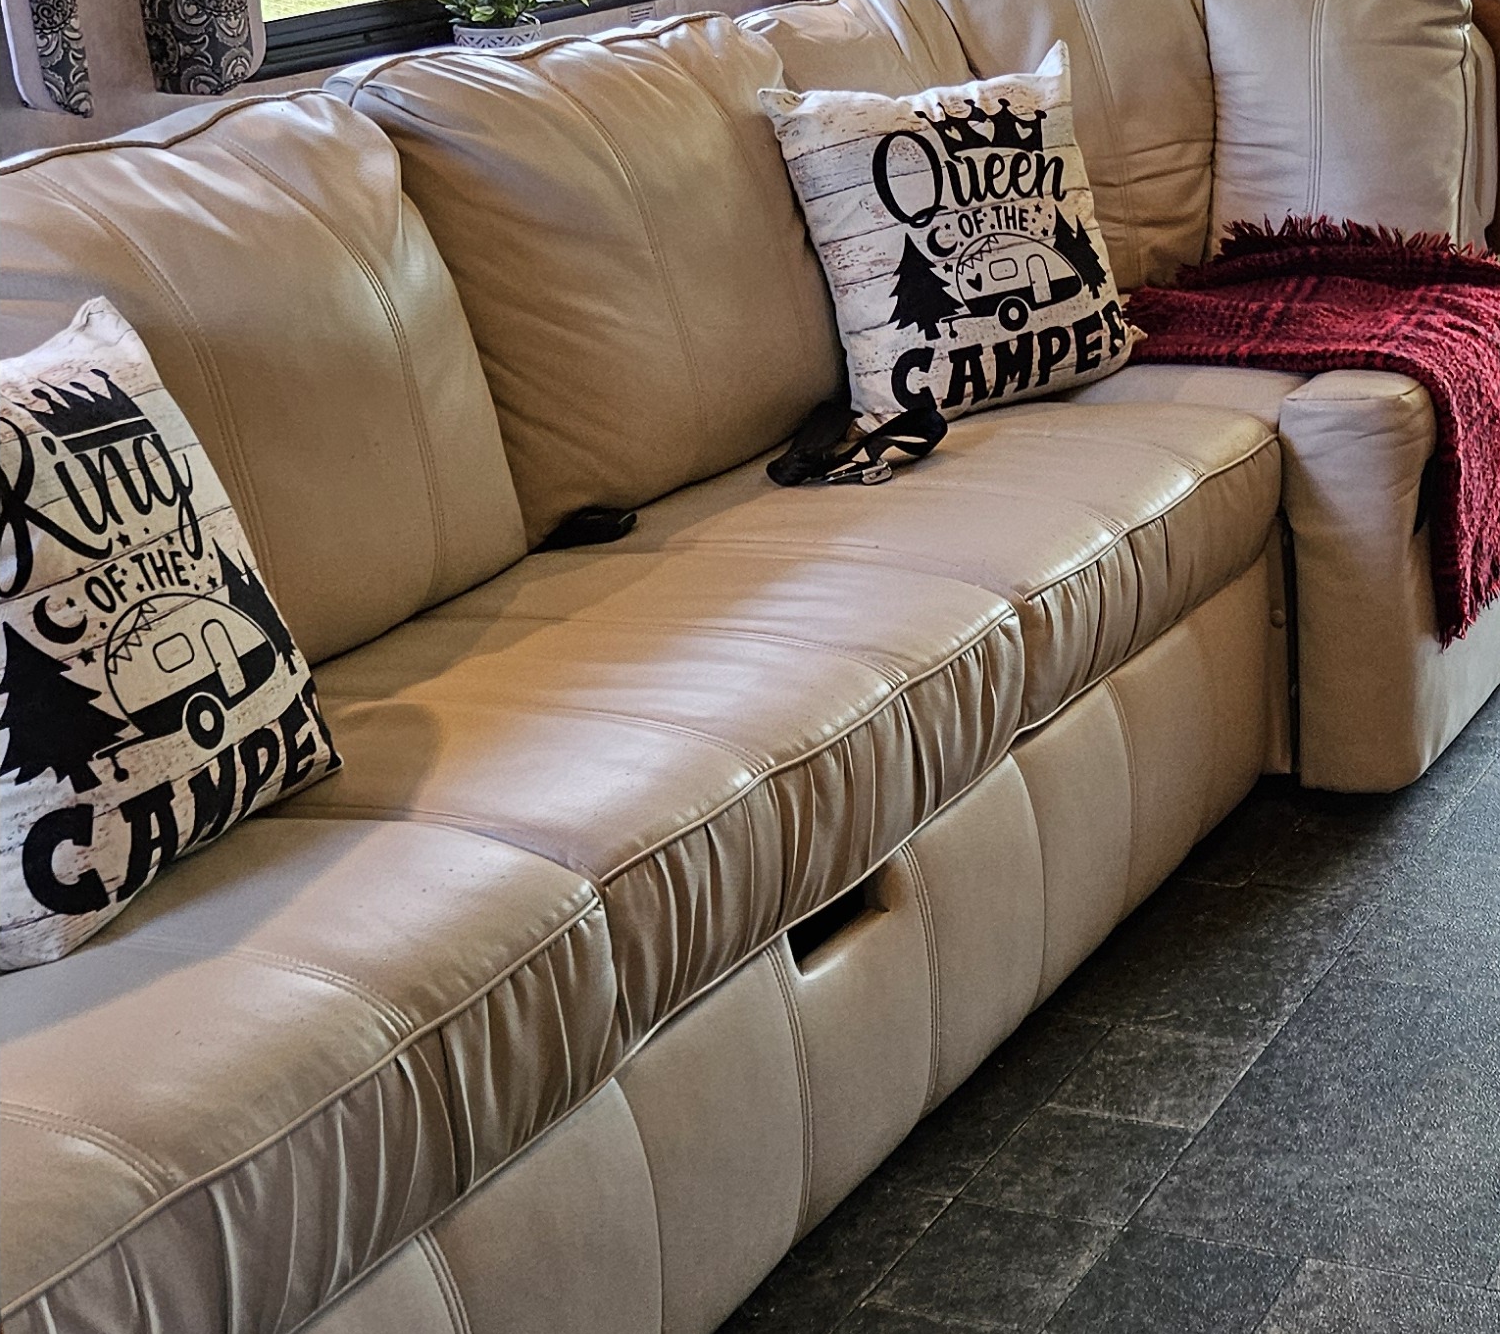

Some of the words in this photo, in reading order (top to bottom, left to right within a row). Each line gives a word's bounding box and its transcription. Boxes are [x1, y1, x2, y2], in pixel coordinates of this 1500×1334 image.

[872, 130, 1067, 229] Queen
[958, 213, 985, 239] OF
[995, 206, 1029, 232] THE
[84, 563, 129, 614] OF
[129, 549, 191, 591] THE
